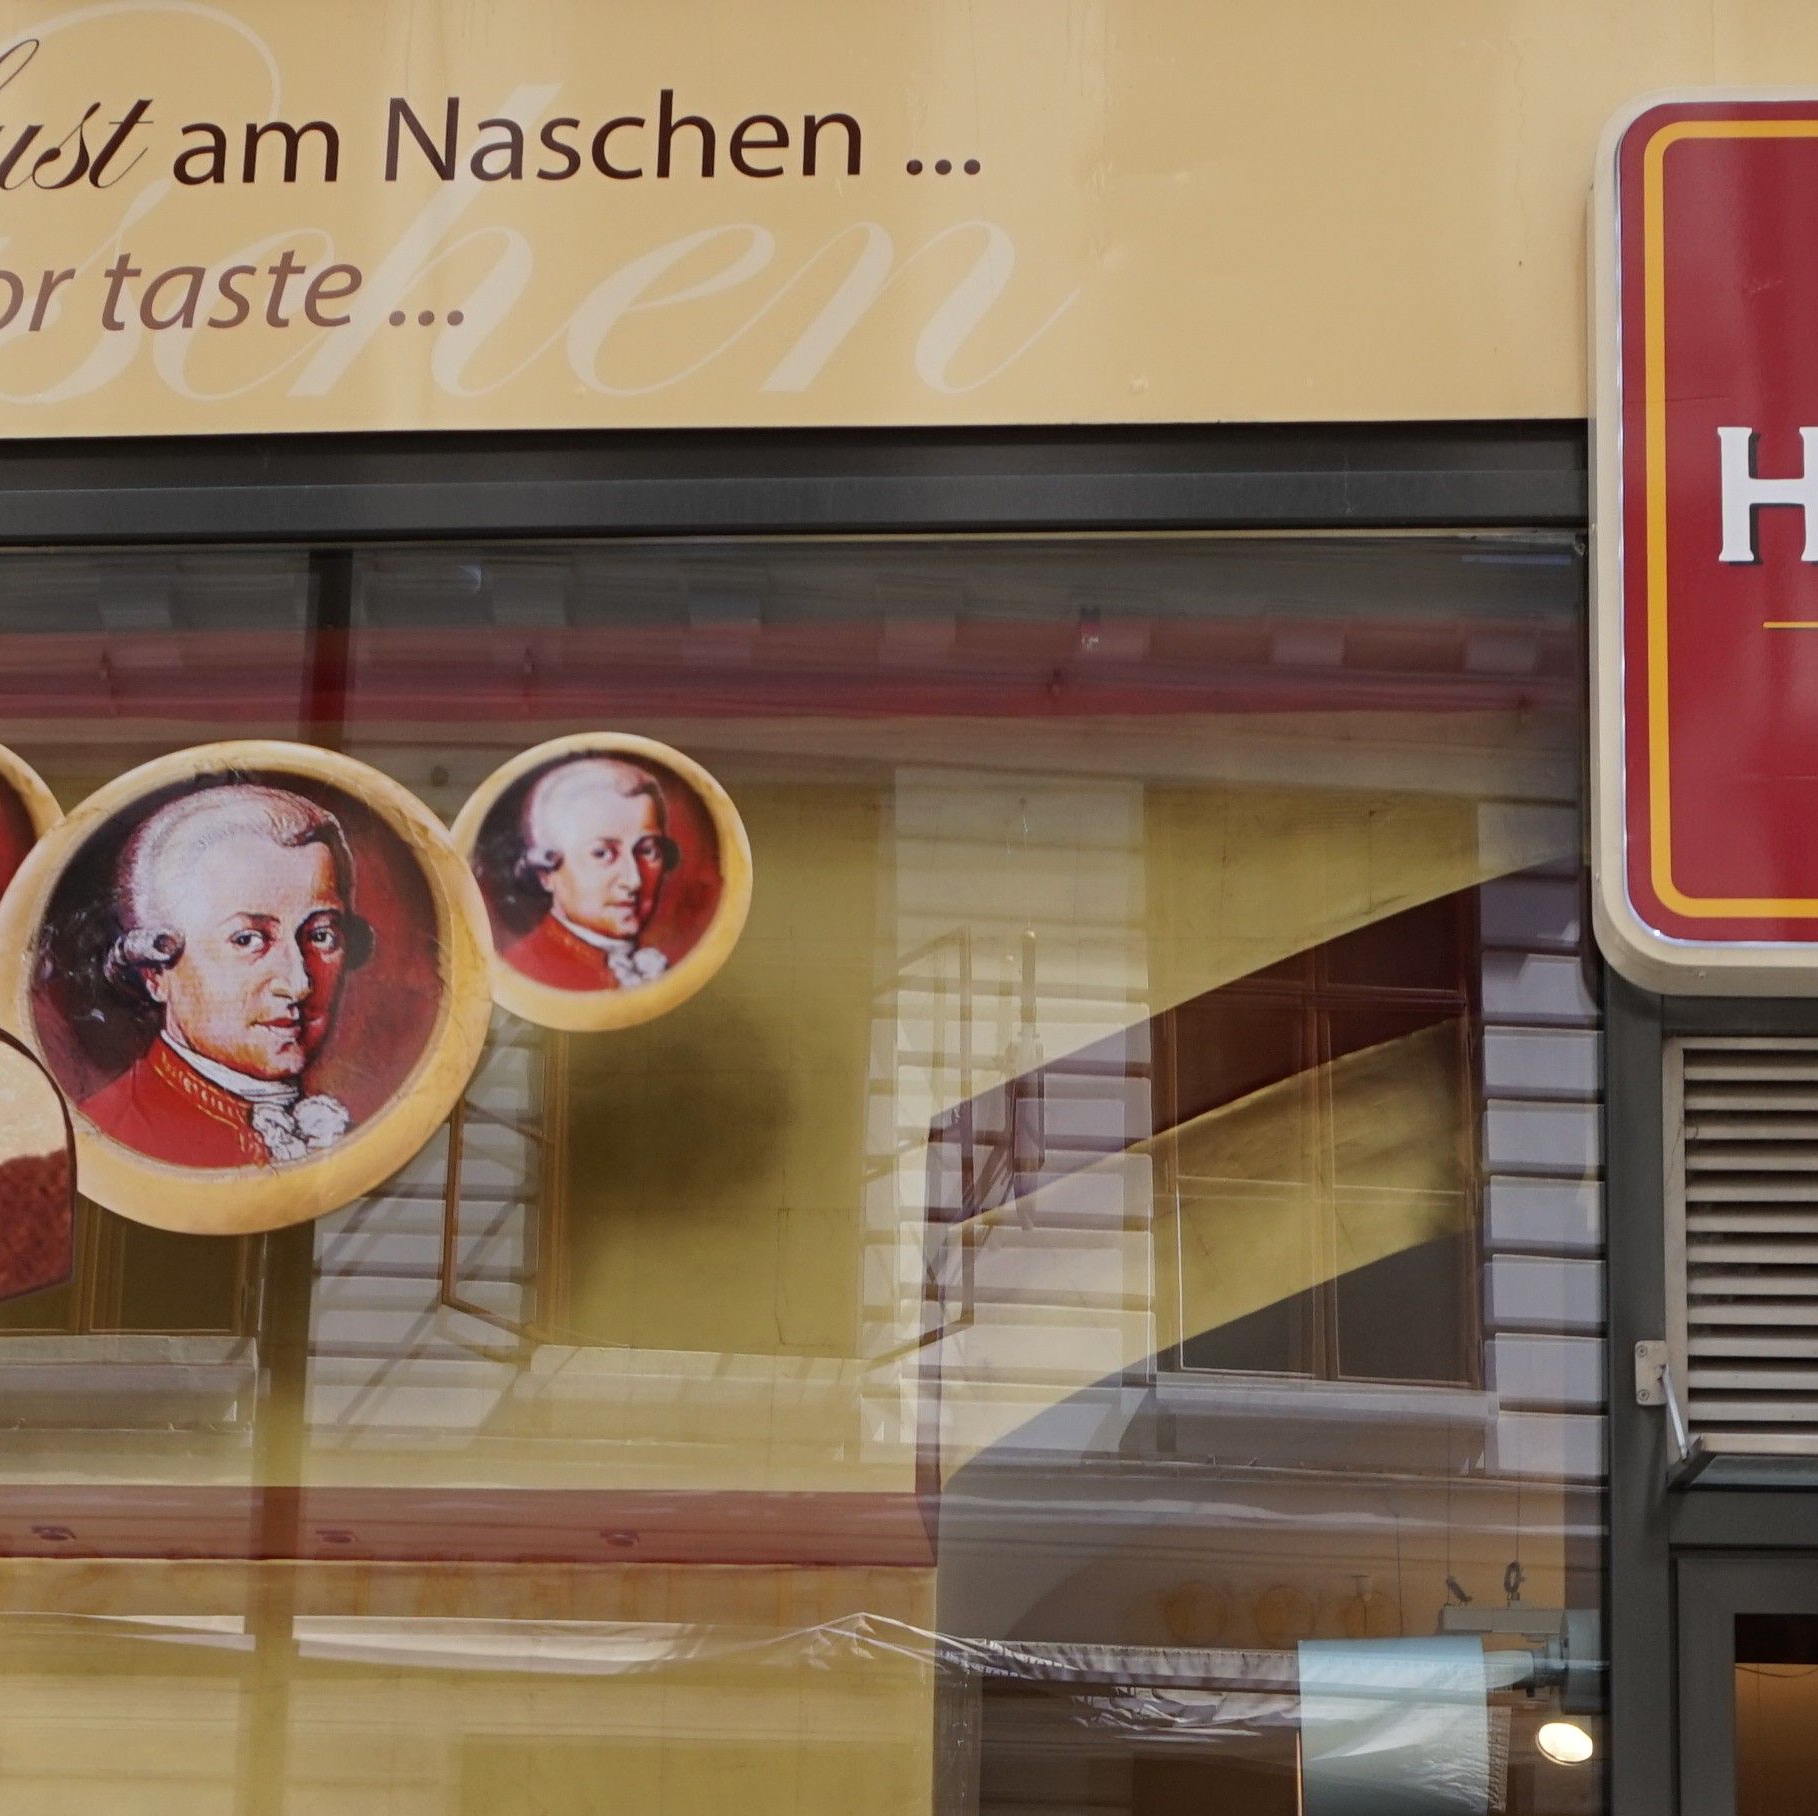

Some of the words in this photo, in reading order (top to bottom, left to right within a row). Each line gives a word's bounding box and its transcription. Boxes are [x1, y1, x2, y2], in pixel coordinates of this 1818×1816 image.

[171, 122, 345, 186] am
[384, 96, 863, 184] Naschen
[98, 252, 361, 332] taste
